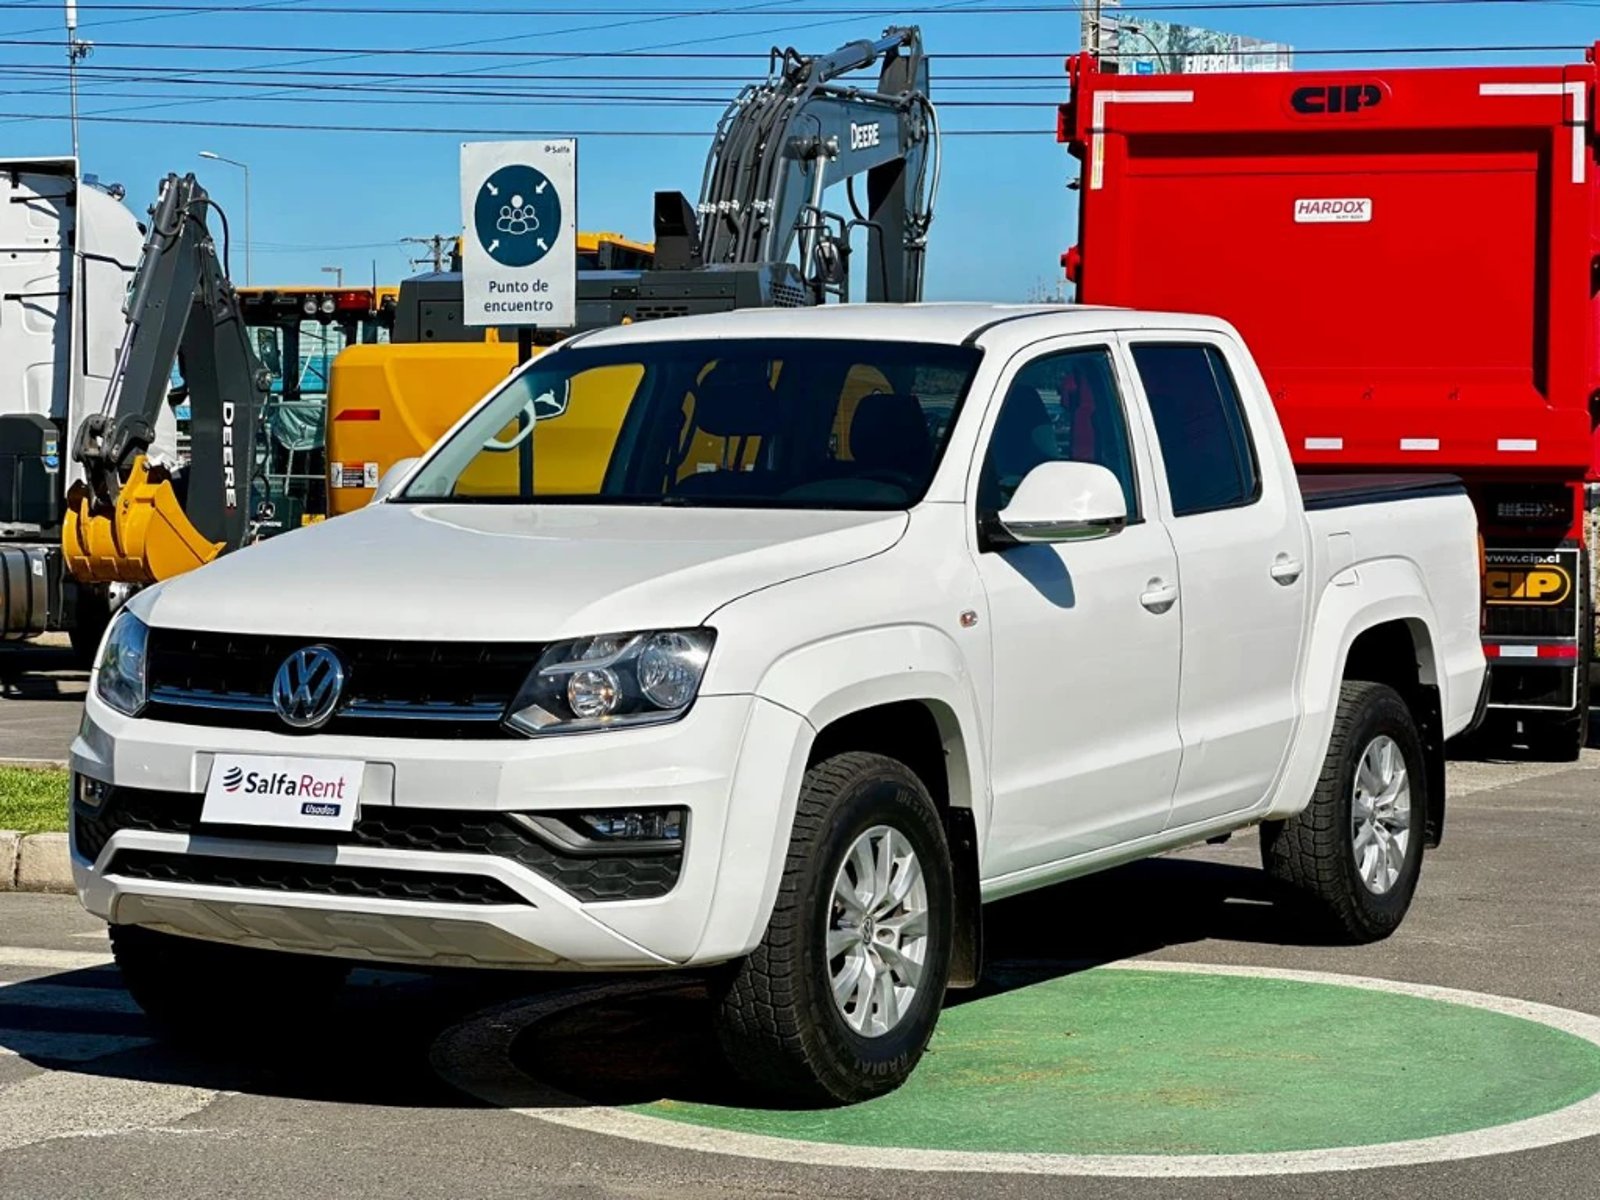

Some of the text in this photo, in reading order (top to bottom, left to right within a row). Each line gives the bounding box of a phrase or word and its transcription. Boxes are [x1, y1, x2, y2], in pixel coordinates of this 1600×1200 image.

[1291, 85, 1382, 113] CIP
[851, 123, 880, 150] DEERE
[1298, 201, 1365, 214] HARDOX
[489, 279, 549, 293] Punto de
[484, 300, 553, 312] encuentro
[223, 401, 237, 508] DEERE
[1485, 571, 1561, 598] CIP
[244, 771, 346, 799] SalfaRent
[305, 804, 336, 815] Usados
